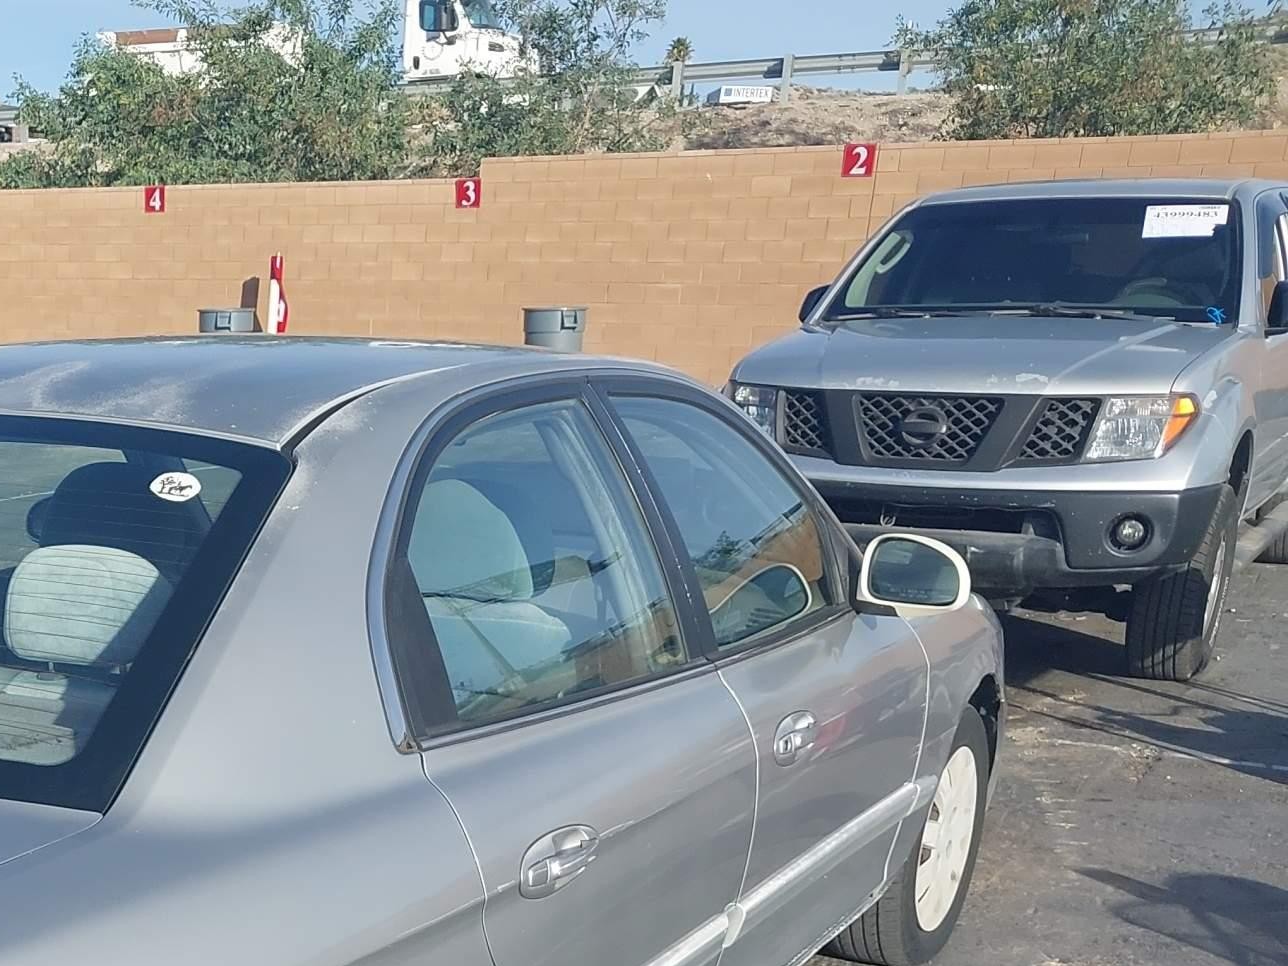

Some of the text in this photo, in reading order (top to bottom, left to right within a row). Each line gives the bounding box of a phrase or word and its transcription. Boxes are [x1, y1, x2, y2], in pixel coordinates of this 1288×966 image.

[733, 87, 770, 98] INTERTEX
[848, 146, 868, 174] 2
[149, 187, 162, 210] 4
[462, 181, 476, 205] 3
